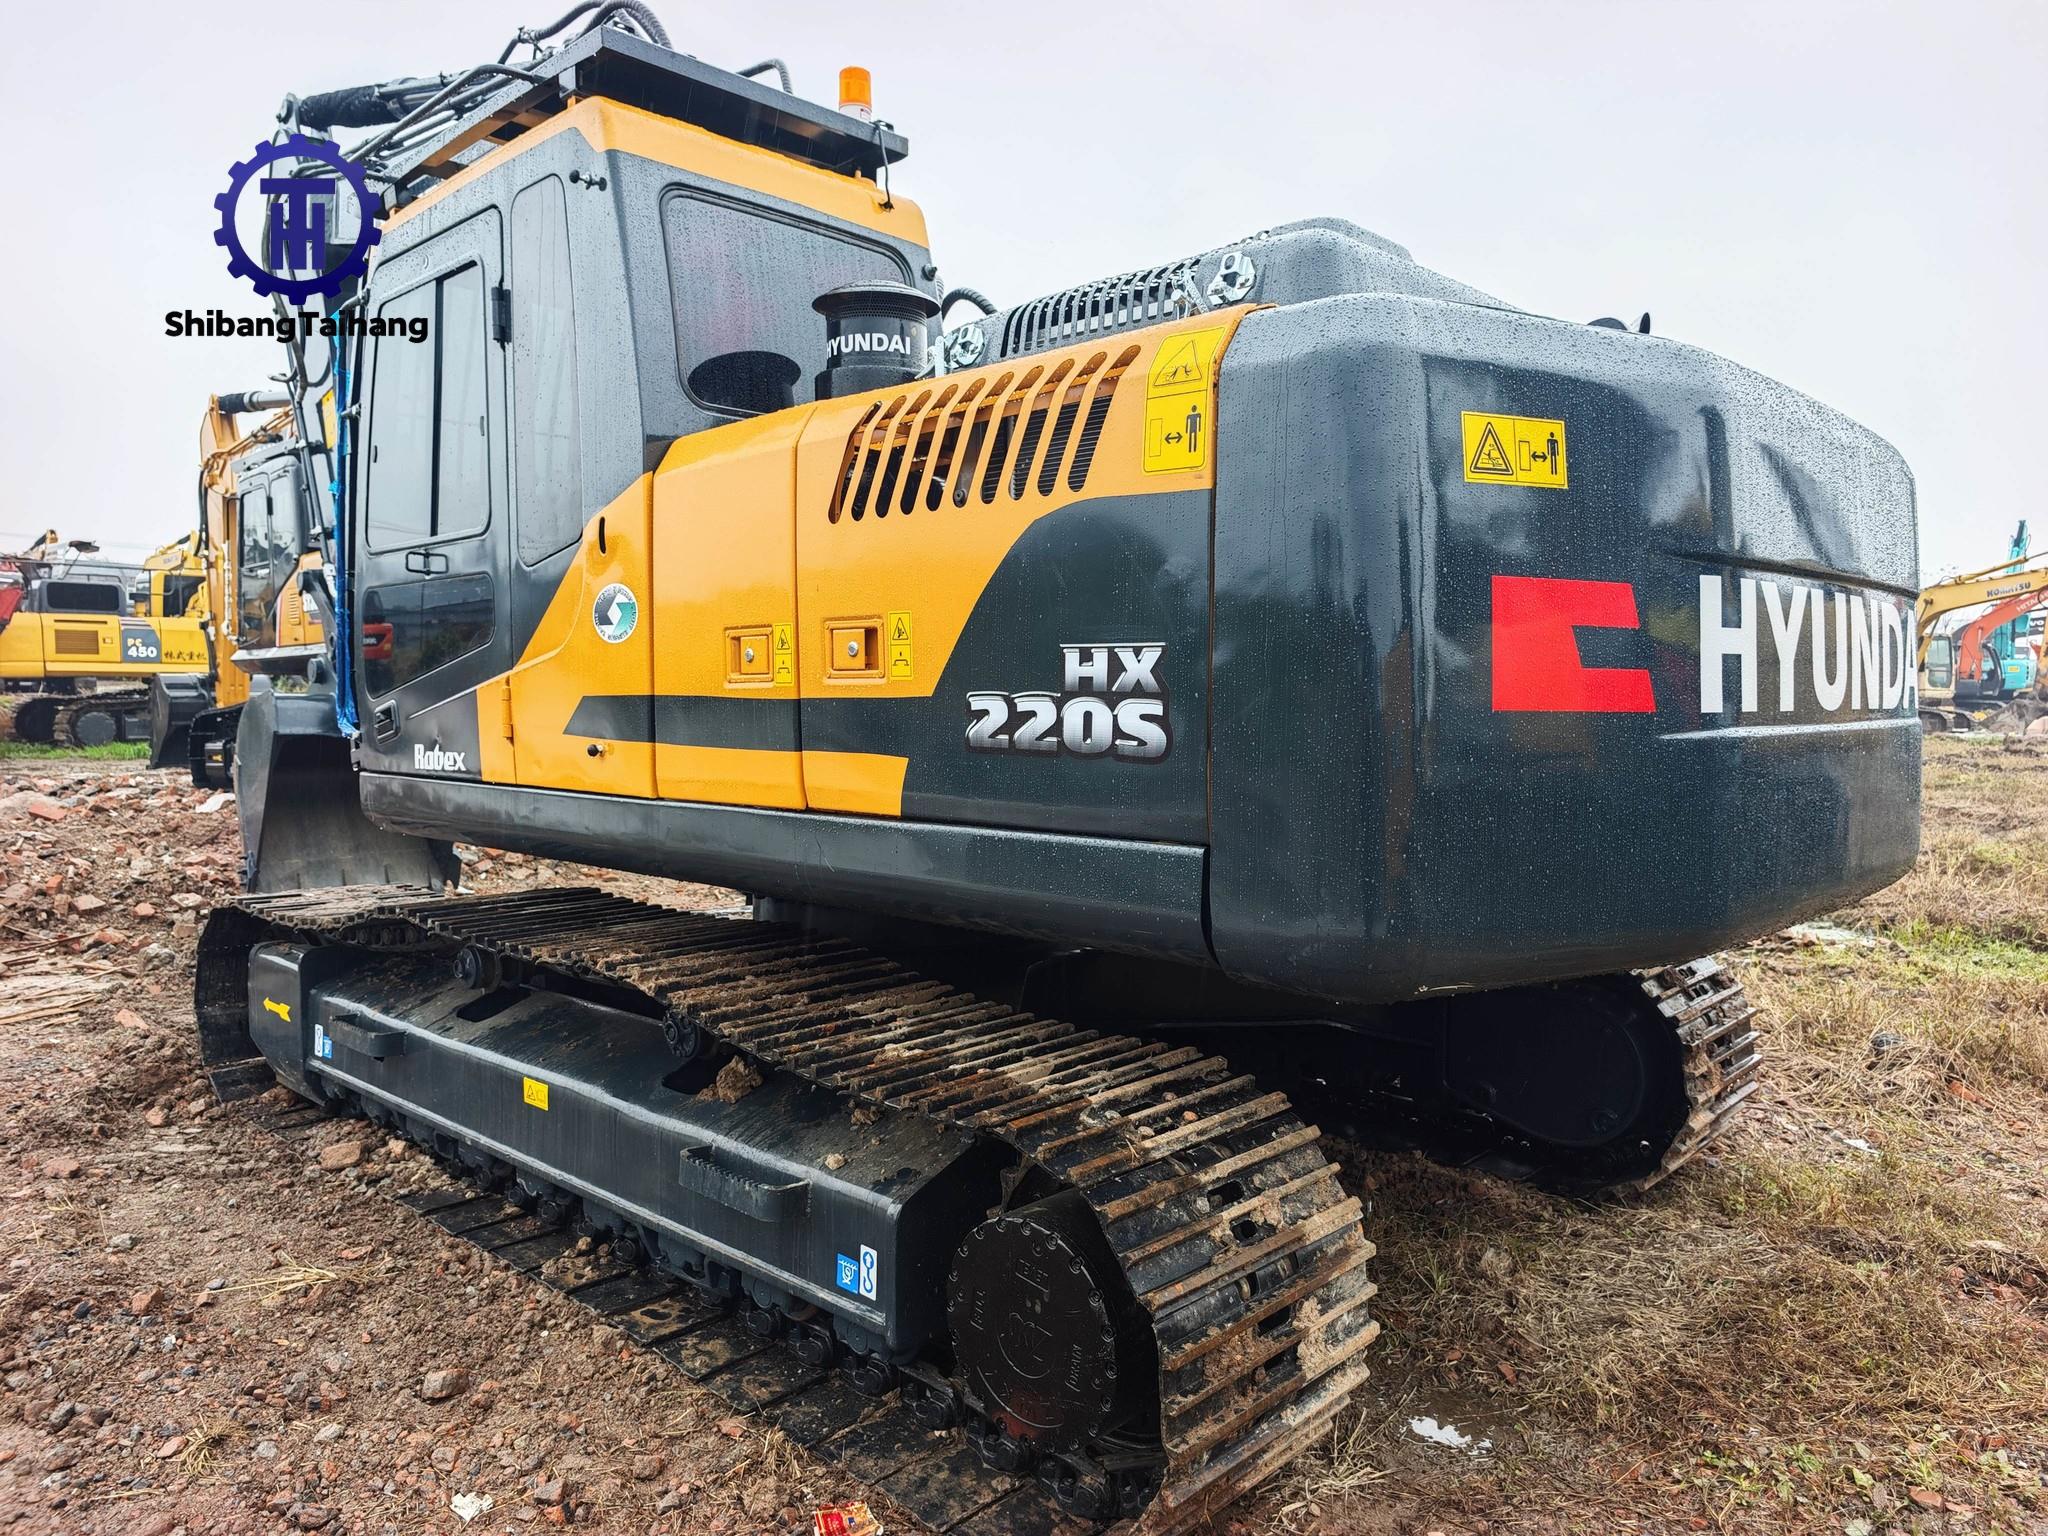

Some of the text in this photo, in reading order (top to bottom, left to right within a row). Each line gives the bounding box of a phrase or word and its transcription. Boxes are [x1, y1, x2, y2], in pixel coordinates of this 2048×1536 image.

[127, 638, 143, 647] PC
[127, 646, 158, 658] 450
[1060, 642, 1166, 692] HX
[965, 691, 1168, 758] 220S
[414, 743, 467, 771] Robex
